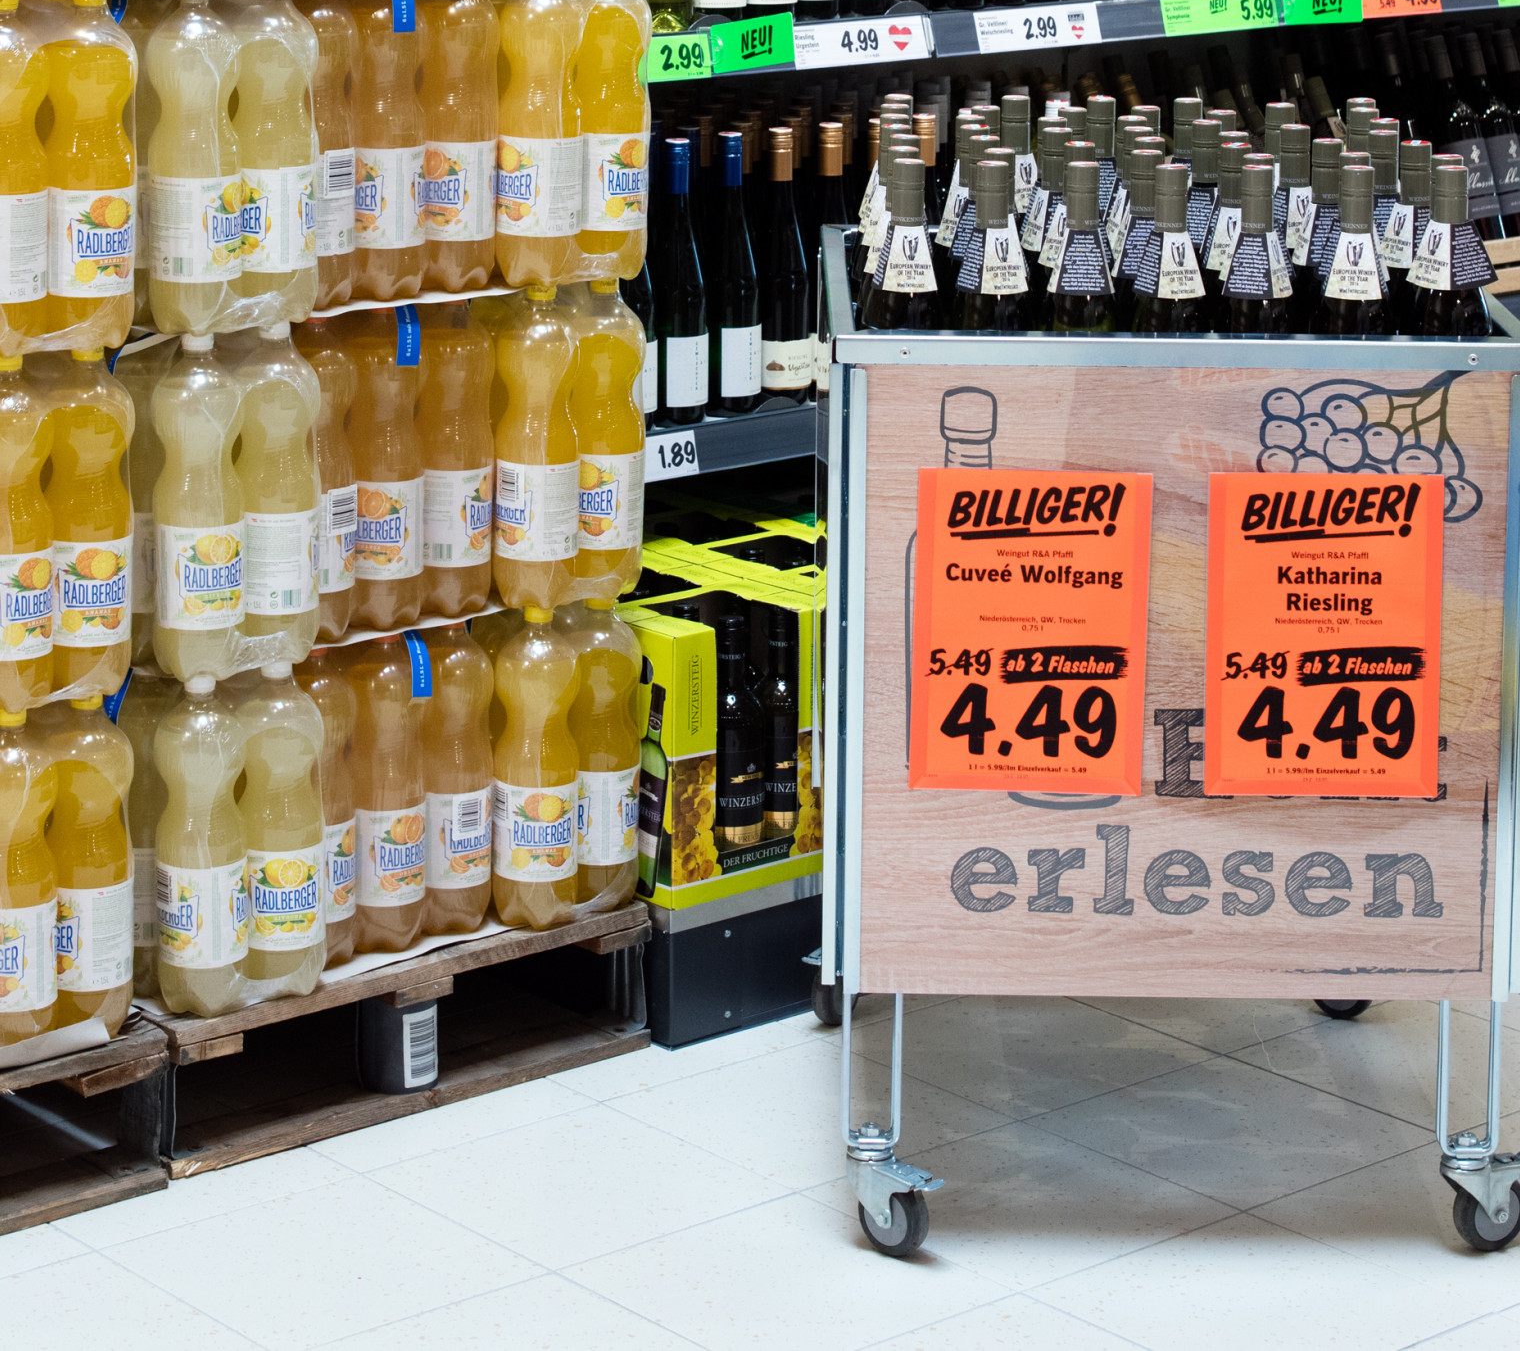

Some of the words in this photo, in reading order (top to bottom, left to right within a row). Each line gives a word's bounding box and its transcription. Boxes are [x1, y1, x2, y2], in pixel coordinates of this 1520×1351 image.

[741, 25, 773, 55] NEU!
[794, 33, 815, 42] Riesling
[841, 28, 879, 53] 4.99
[1023, 16, 1058, 40] 2.99
[660, 42, 704, 72] 2.99
[795, 41, 820, 50] Urgestein
[658, 440, 696, 469] 1.89
[947, 482, 1126, 537] BILLIGER!
[1241, 483, 1421, 537] BILLIGER!
[996, 549, 1030, 559] Weingut
[1032, 550, 1051, 558] R&A
[1291, 551, 1325, 560] Weingut
[945, 563, 1013, 583] Cuveé
[1020, 564, 1124, 589] Wolfgang
[1277, 565, 1382, 585] Katharina
[63, 575, 126, 604] RADLBERGER
[1286, 593, 1373, 616] Riesling
[979, 614, 1039, 624] Niederösterreich,
[1040, 616, 1057, 624] QW,
[1275, 617, 1335, 626] Niederösterreich,
[1336, 618, 1353, 626] QW,
[929, 648, 992, 676] 5.49
[1006, 654, 1027, 672] ab
[1030, 652, 1044, 673] 2
[1048, 655, 1115, 675] Flaschen
[1225, 652, 1288, 679] 5.49
[1303, 657, 1323, 675] ab
[1327, 654, 1341, 675] 2
[1345, 656, 1412, 676] Flaschen
[690, 654, 700, 736] WINZERSTEIG
[940, 683, 1117, 759] 4.49
[1237, 686, 1415, 760] 4.49
[1017, 765, 1062, 773] Einzelverkauf
[513, 819, 572, 844] RADLBERGER
[723, 856, 741, 868] DER
[741, 843, 789, 864] FRUCHTIGE
[951, 823, 1443, 917] erlesen
[255, 878, 318, 909] RADLBERGER
